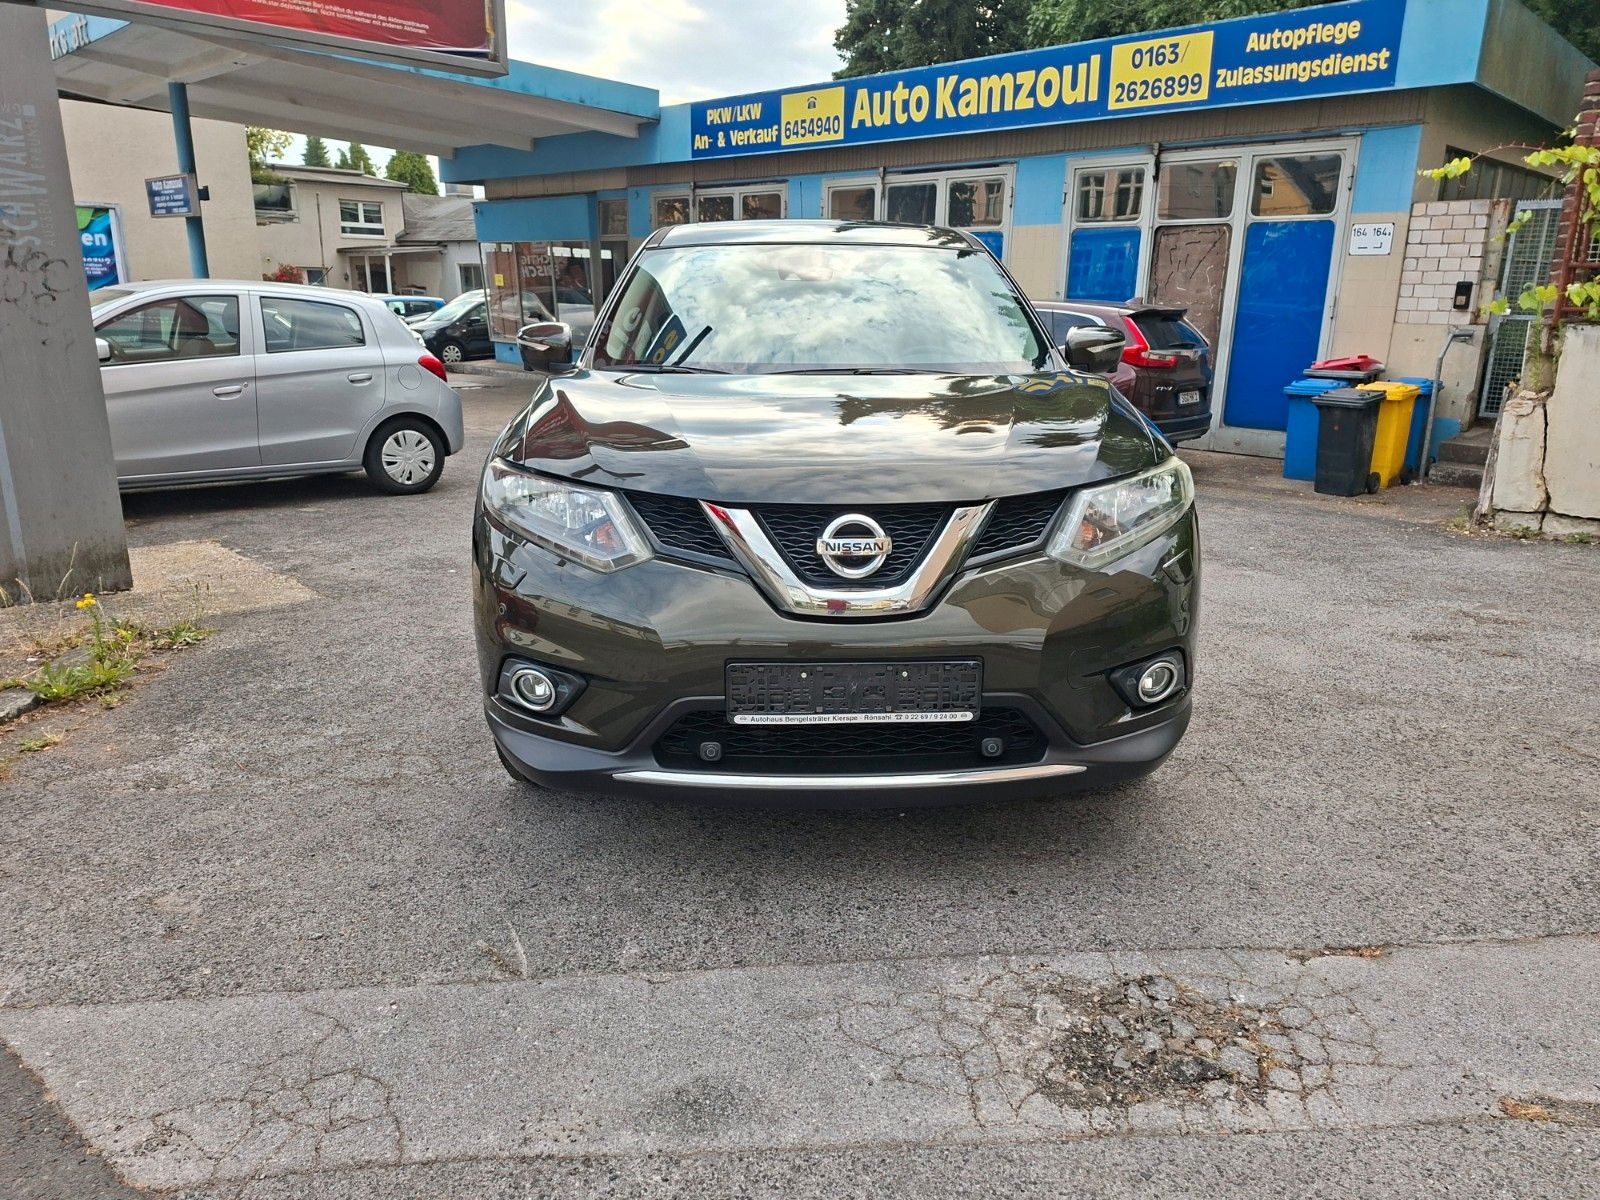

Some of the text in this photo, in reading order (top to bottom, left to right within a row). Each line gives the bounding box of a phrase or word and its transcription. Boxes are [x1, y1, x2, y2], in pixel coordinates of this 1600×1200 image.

[1246, 20, 1361, 53] Autopflege
[1215, 47, 1391, 88] Zulassungsdienst
[851, 54, 1101, 129] Auto Kamzoul
[1114, 72, 1203, 104] 2626899
[706, 102, 762, 126] PKW/LKW
[784, 114, 841, 140] 6454940
[694, 124, 778, 150] An- & Verkauf
[1353, 227, 1367, 237] 164
[825, 541, 884, 552] NISSAN
